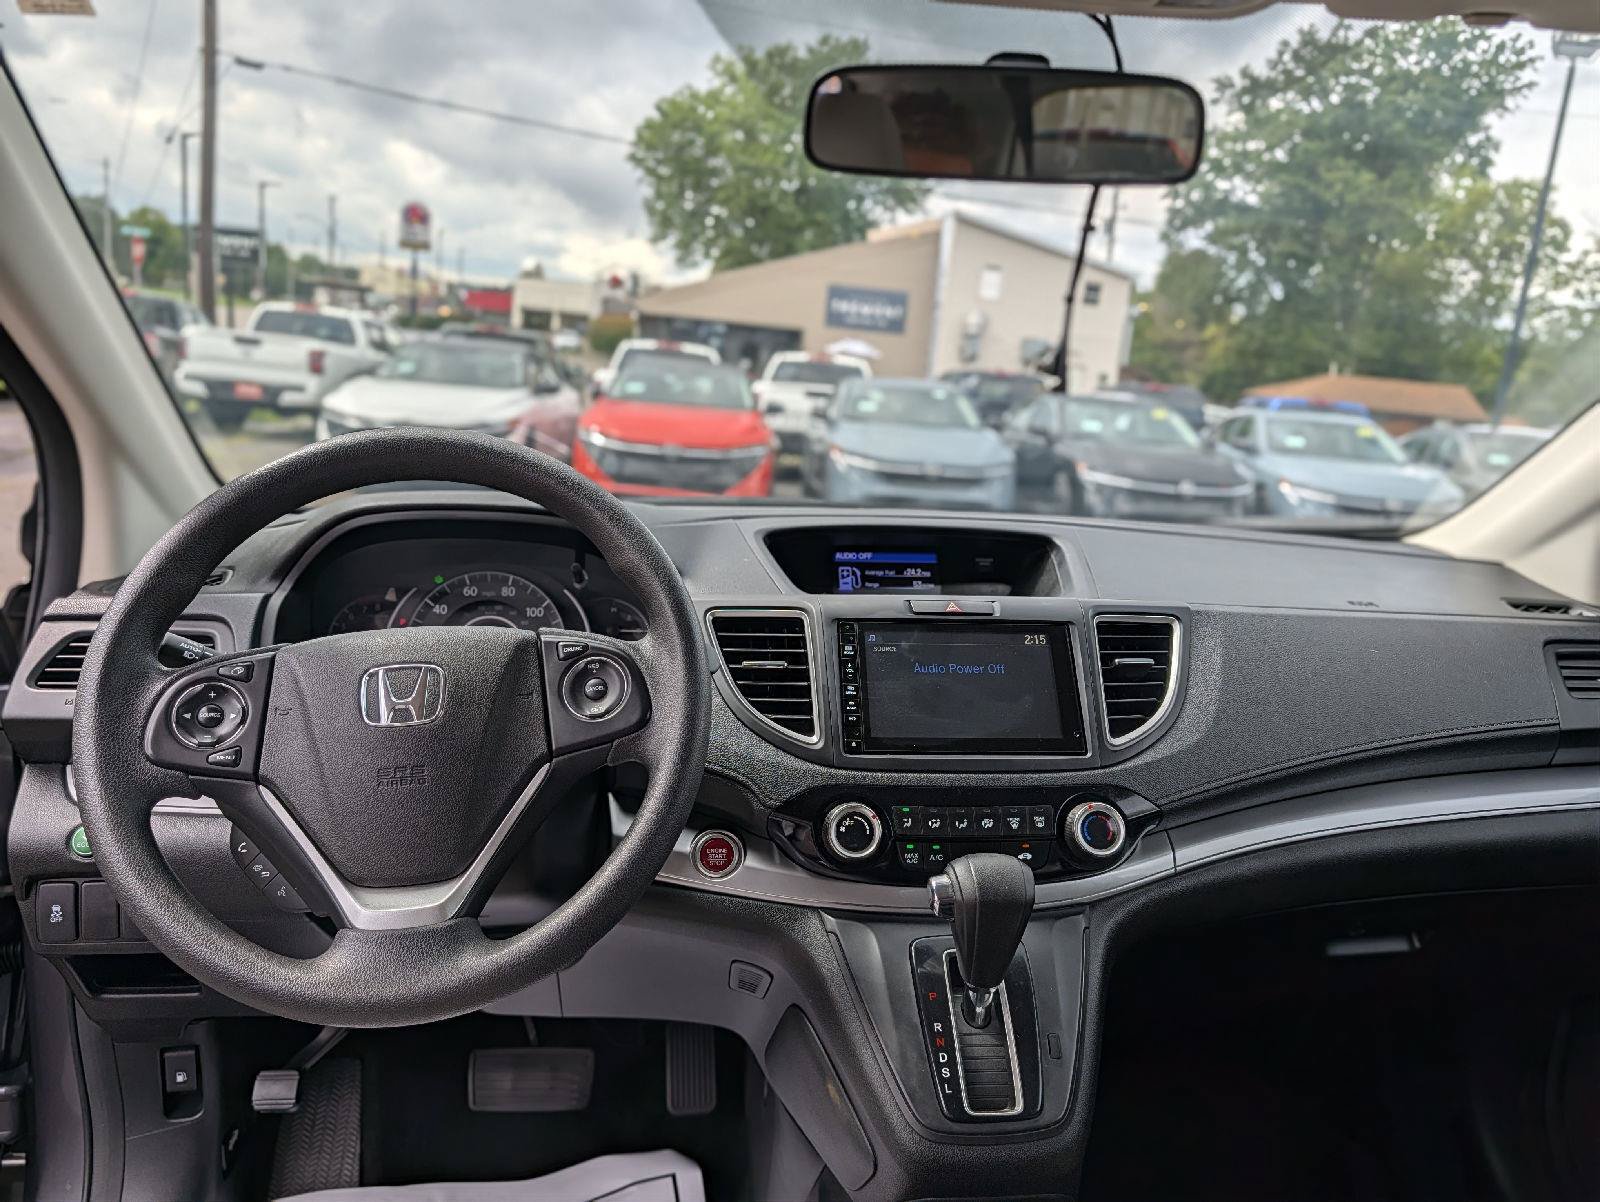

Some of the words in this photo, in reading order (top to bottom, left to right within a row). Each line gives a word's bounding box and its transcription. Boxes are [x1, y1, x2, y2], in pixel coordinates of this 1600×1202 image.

[463, 586, 478, 597] 60
[501, 586, 516, 597] 80
[432, 604, 448, 615] 40
[525, 607, 545, 617] 100
[1024, 634, 1047, 645] 2:15
[914, 663, 945, 674] Audio
[949, 663, 984, 674] Power
[987, 663, 1006, 674] Off
[929, 992, 936, 1000] P
[934, 1023, 943, 1032] R
[937, 1038, 944, 1047] N
[940, 1052, 948, 1062] D
[941, 1068, 950, 1078] S
[945, 1084, 952, 1093] L
